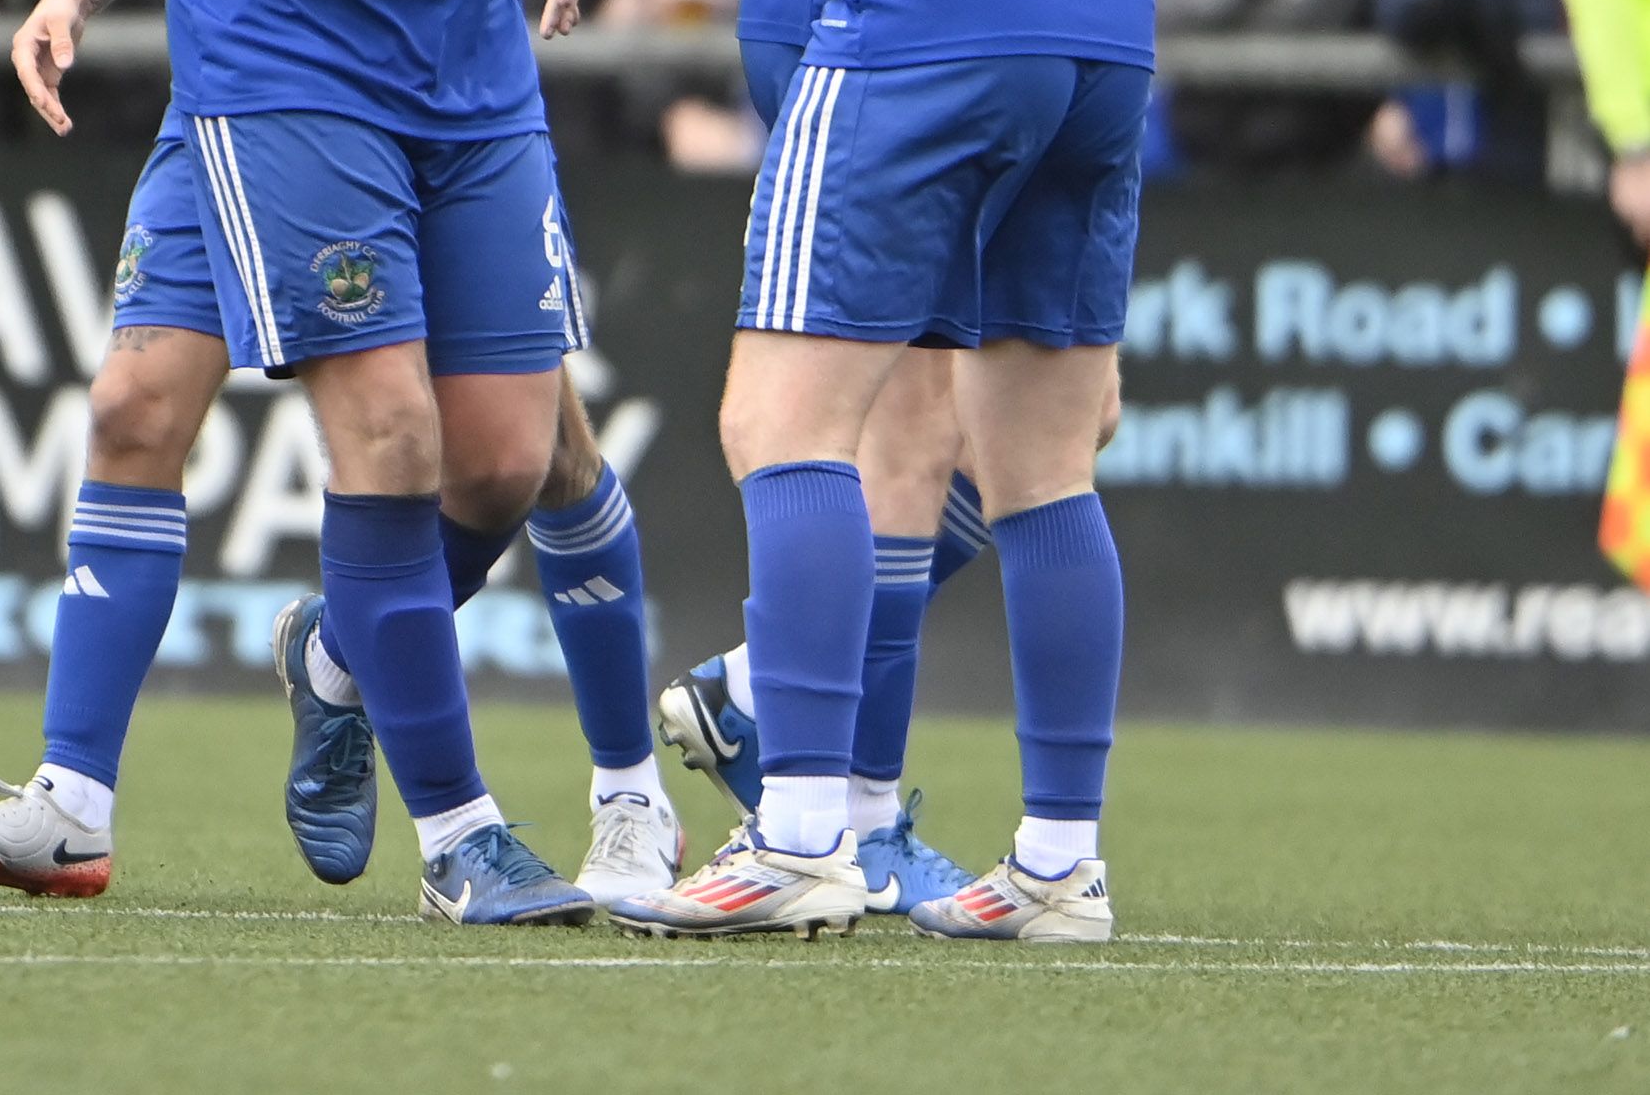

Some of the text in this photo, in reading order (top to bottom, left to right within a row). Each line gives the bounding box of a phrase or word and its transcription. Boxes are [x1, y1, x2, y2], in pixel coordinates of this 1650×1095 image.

[310, 241, 361, 273] DERRIAGHY
[317, 290, 386, 323] FOOTBALL CLUB
[1124, 260, 1237, 360] rk
[1254, 260, 1520, 367] Road
[1095, 387, 1618, 494] ankill Car
